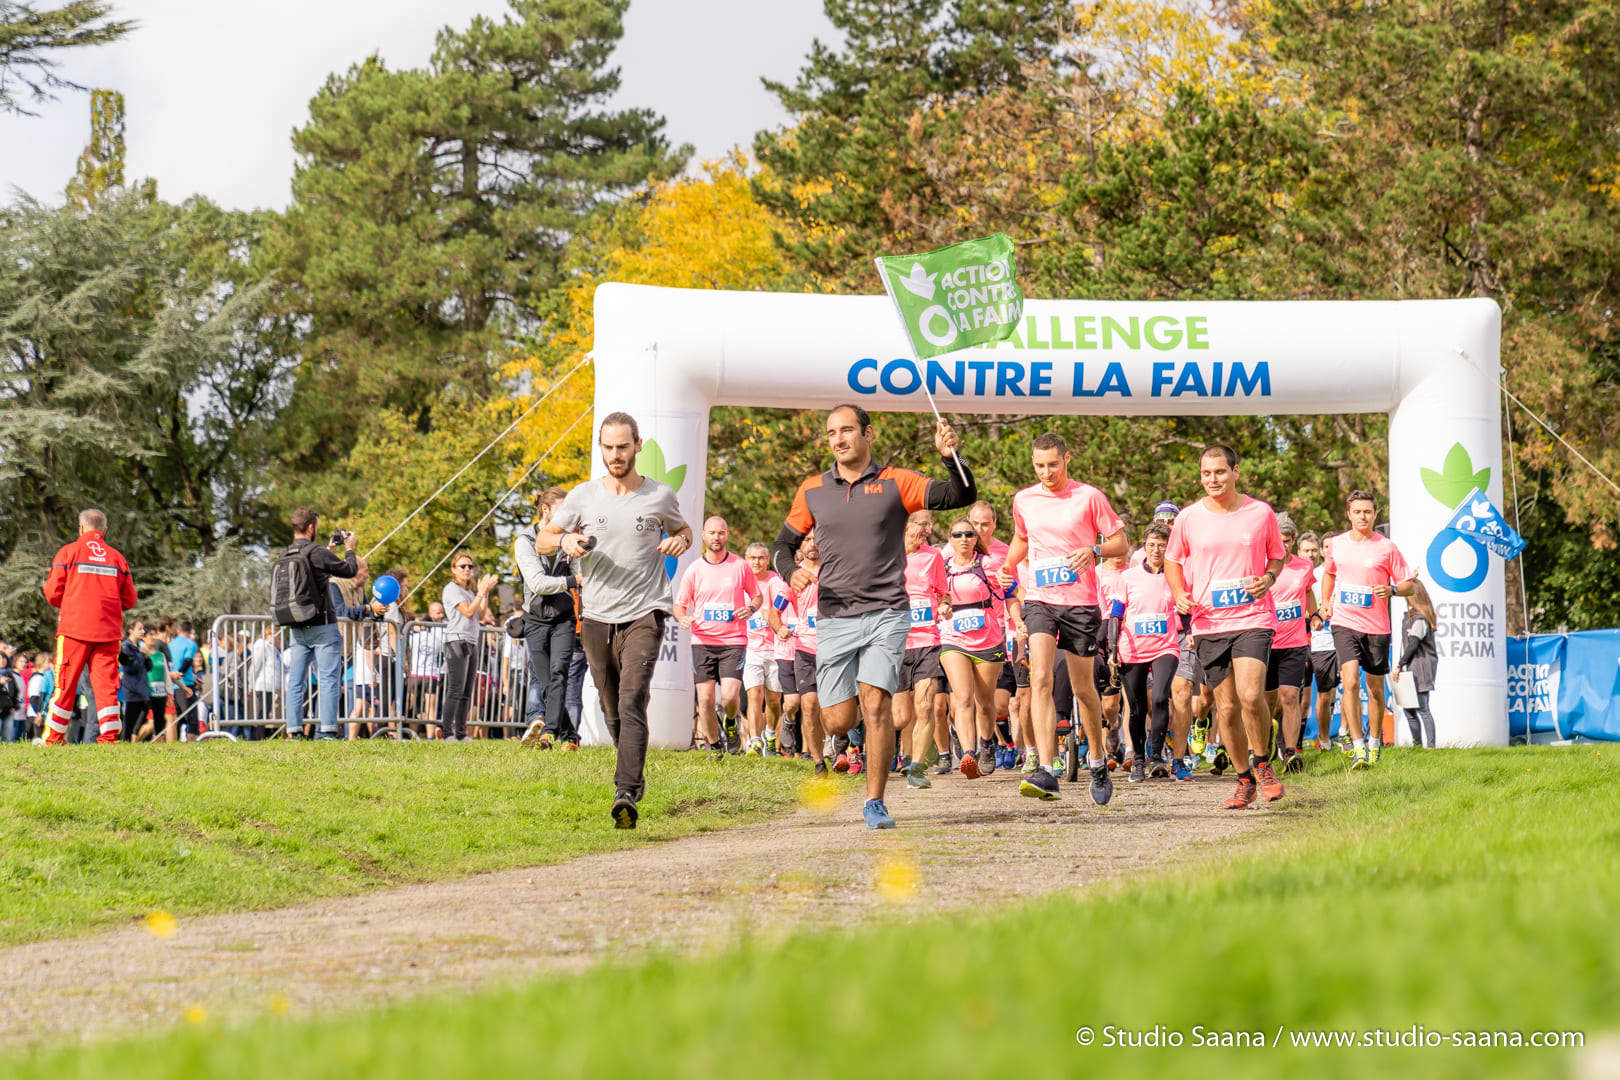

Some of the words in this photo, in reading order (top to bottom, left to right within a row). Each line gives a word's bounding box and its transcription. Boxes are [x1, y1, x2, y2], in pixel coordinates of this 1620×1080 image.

[972, 300, 1022, 329] FAIM
[847, 358, 1053, 397] CONTRE
[1072, 362, 1132, 397] LA
[1151, 361, 1272, 397] FAIM
[1041, 566, 1070, 584] 176
[1218, 588, 1250, 605] 412
[1344, 591, 1366, 605] 381
[708, 609, 730, 622] 138
[1277, 608, 1298, 621] 231
[1436, 602, 1494, 620] CTION
[957, 616, 980, 632] 203
[1140, 620, 1162, 633] 151
[1436, 622, 1495, 639] ONTRE
[1450, 640, 1495, 658] FAIM
[1508, 680, 1550, 697] CONTR
[1528, 696, 1552, 713] FAI
